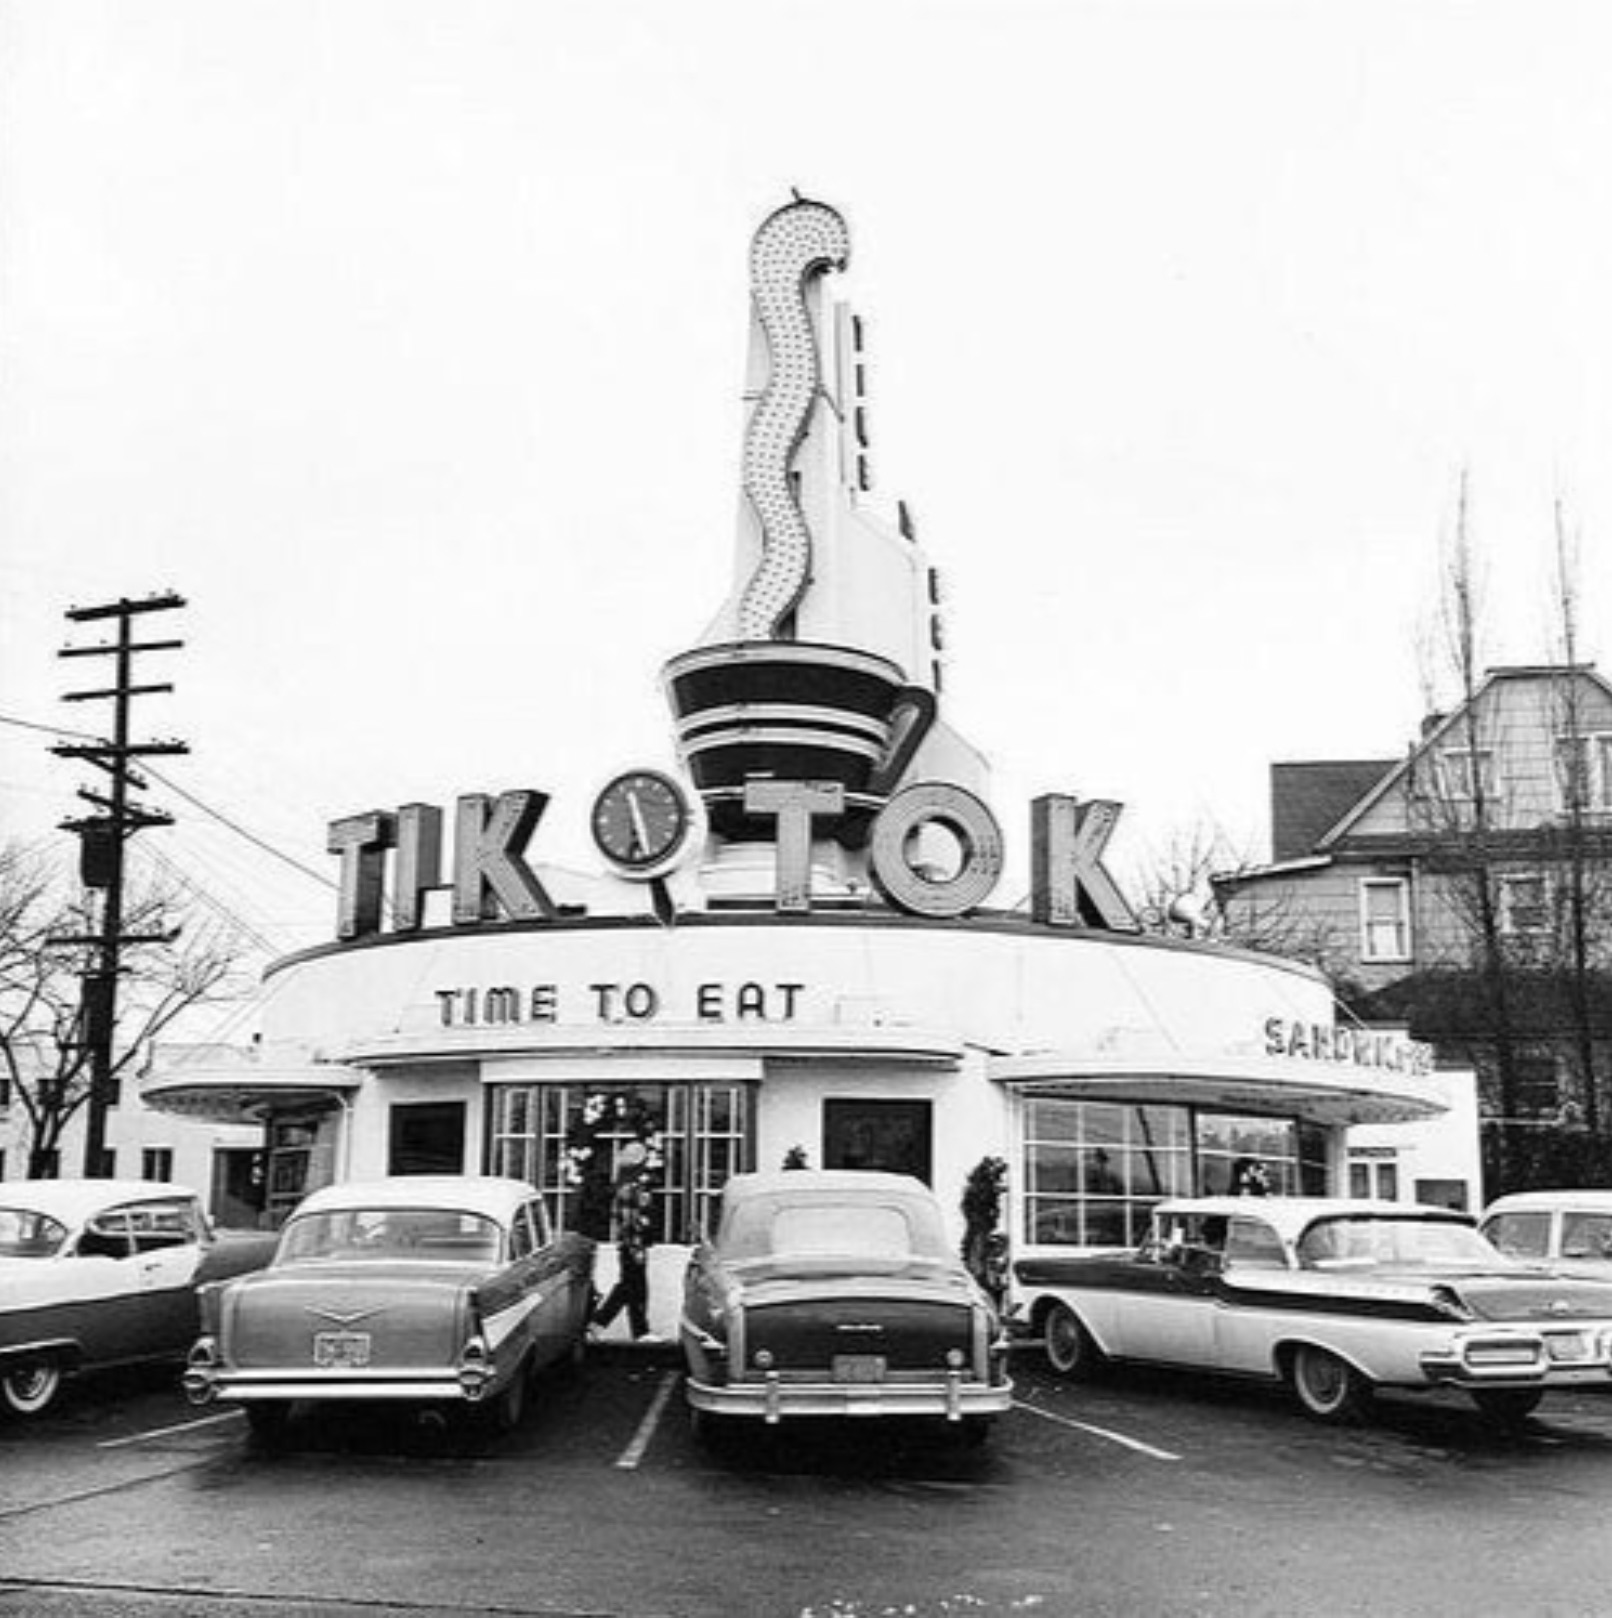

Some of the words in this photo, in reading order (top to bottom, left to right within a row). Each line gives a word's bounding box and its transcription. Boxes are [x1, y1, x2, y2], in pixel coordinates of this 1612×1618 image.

[327, 789, 556, 941] TIK
[743, 781, 1142, 936] TOK
[434, 984, 558, 1028] TIME
[589, 982, 659, 1024] TO
[697, 982, 805, 1021] EAT
